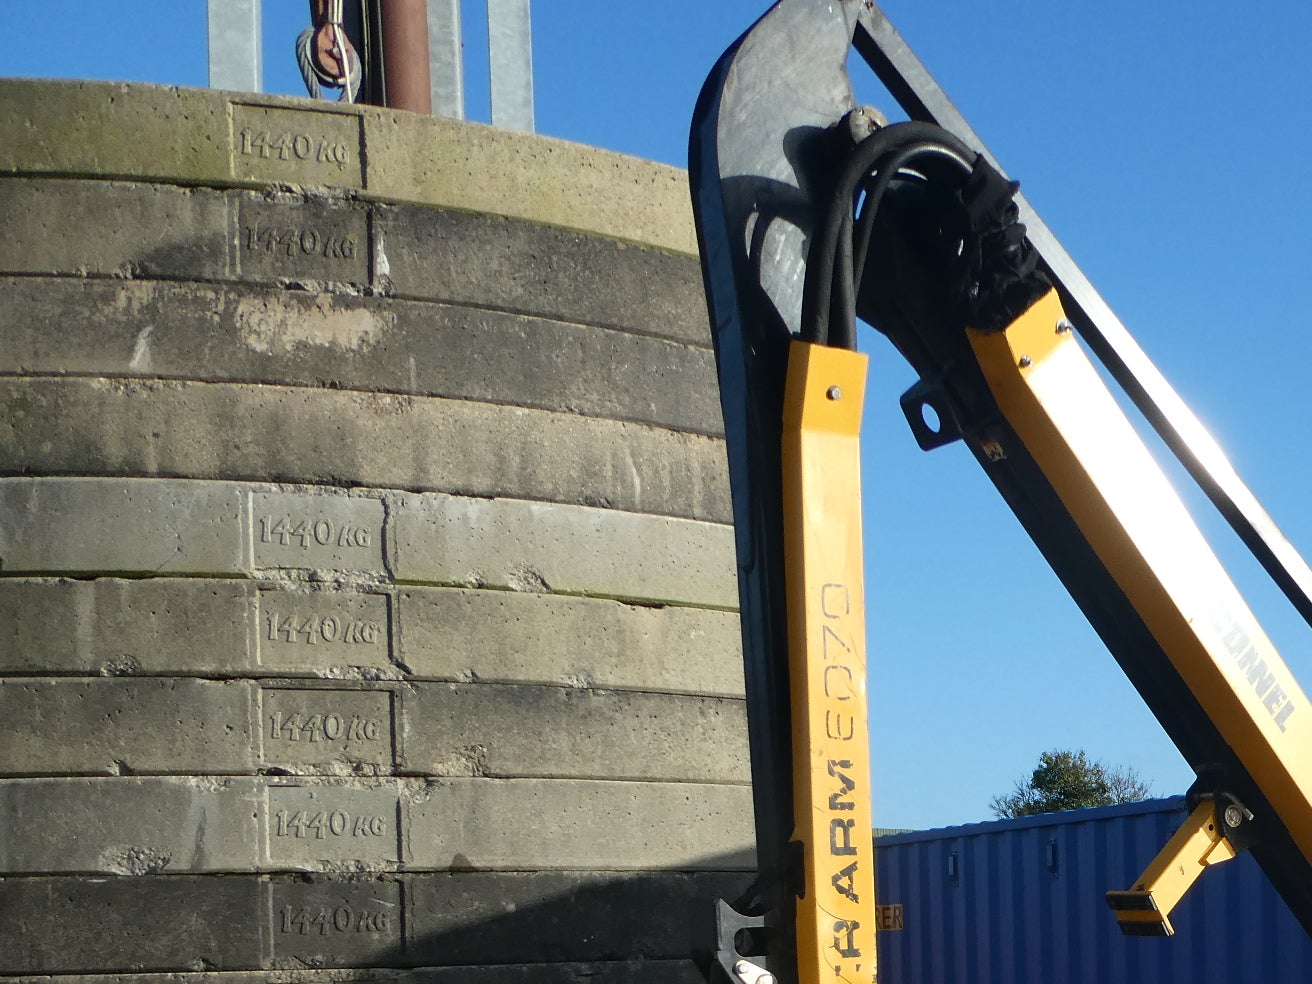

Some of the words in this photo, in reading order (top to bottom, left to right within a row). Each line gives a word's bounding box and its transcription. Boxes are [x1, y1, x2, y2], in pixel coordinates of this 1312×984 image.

[241, 127, 314, 160] 1440
[246, 226, 321, 256] 1440
[260, 515, 335, 548] 1440
[267, 612, 341, 645] 1440
[270, 711, 345, 743] 1440
[276, 808, 350, 839] 1440
[280, 904, 354, 936] 1440
